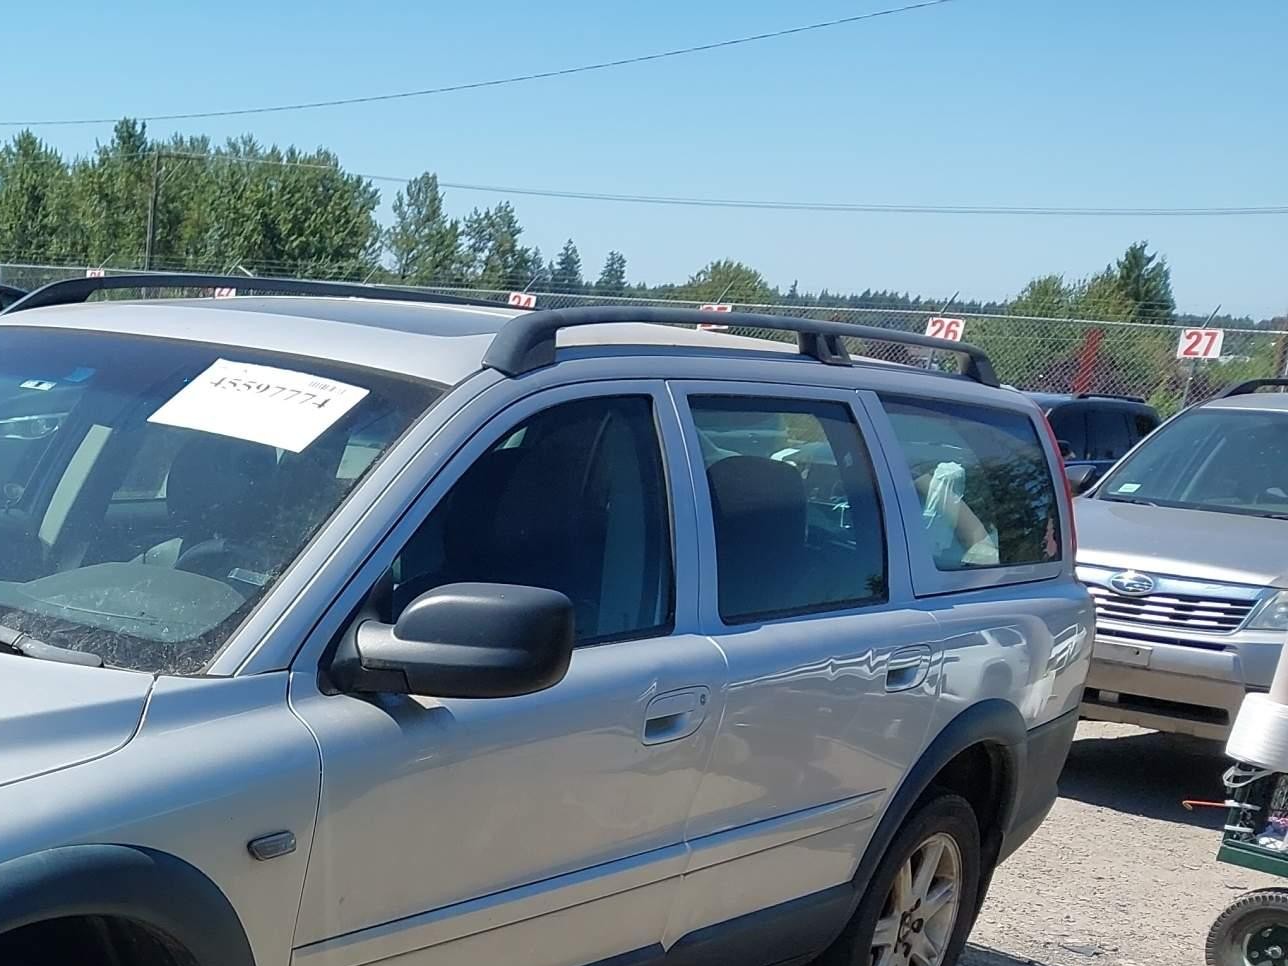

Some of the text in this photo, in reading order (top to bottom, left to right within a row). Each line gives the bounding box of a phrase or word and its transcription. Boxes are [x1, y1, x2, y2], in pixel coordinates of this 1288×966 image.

[931, 319, 961, 340] 26
[1182, 330, 1219, 357] 27
[210, 377, 332, 409] 45597774
